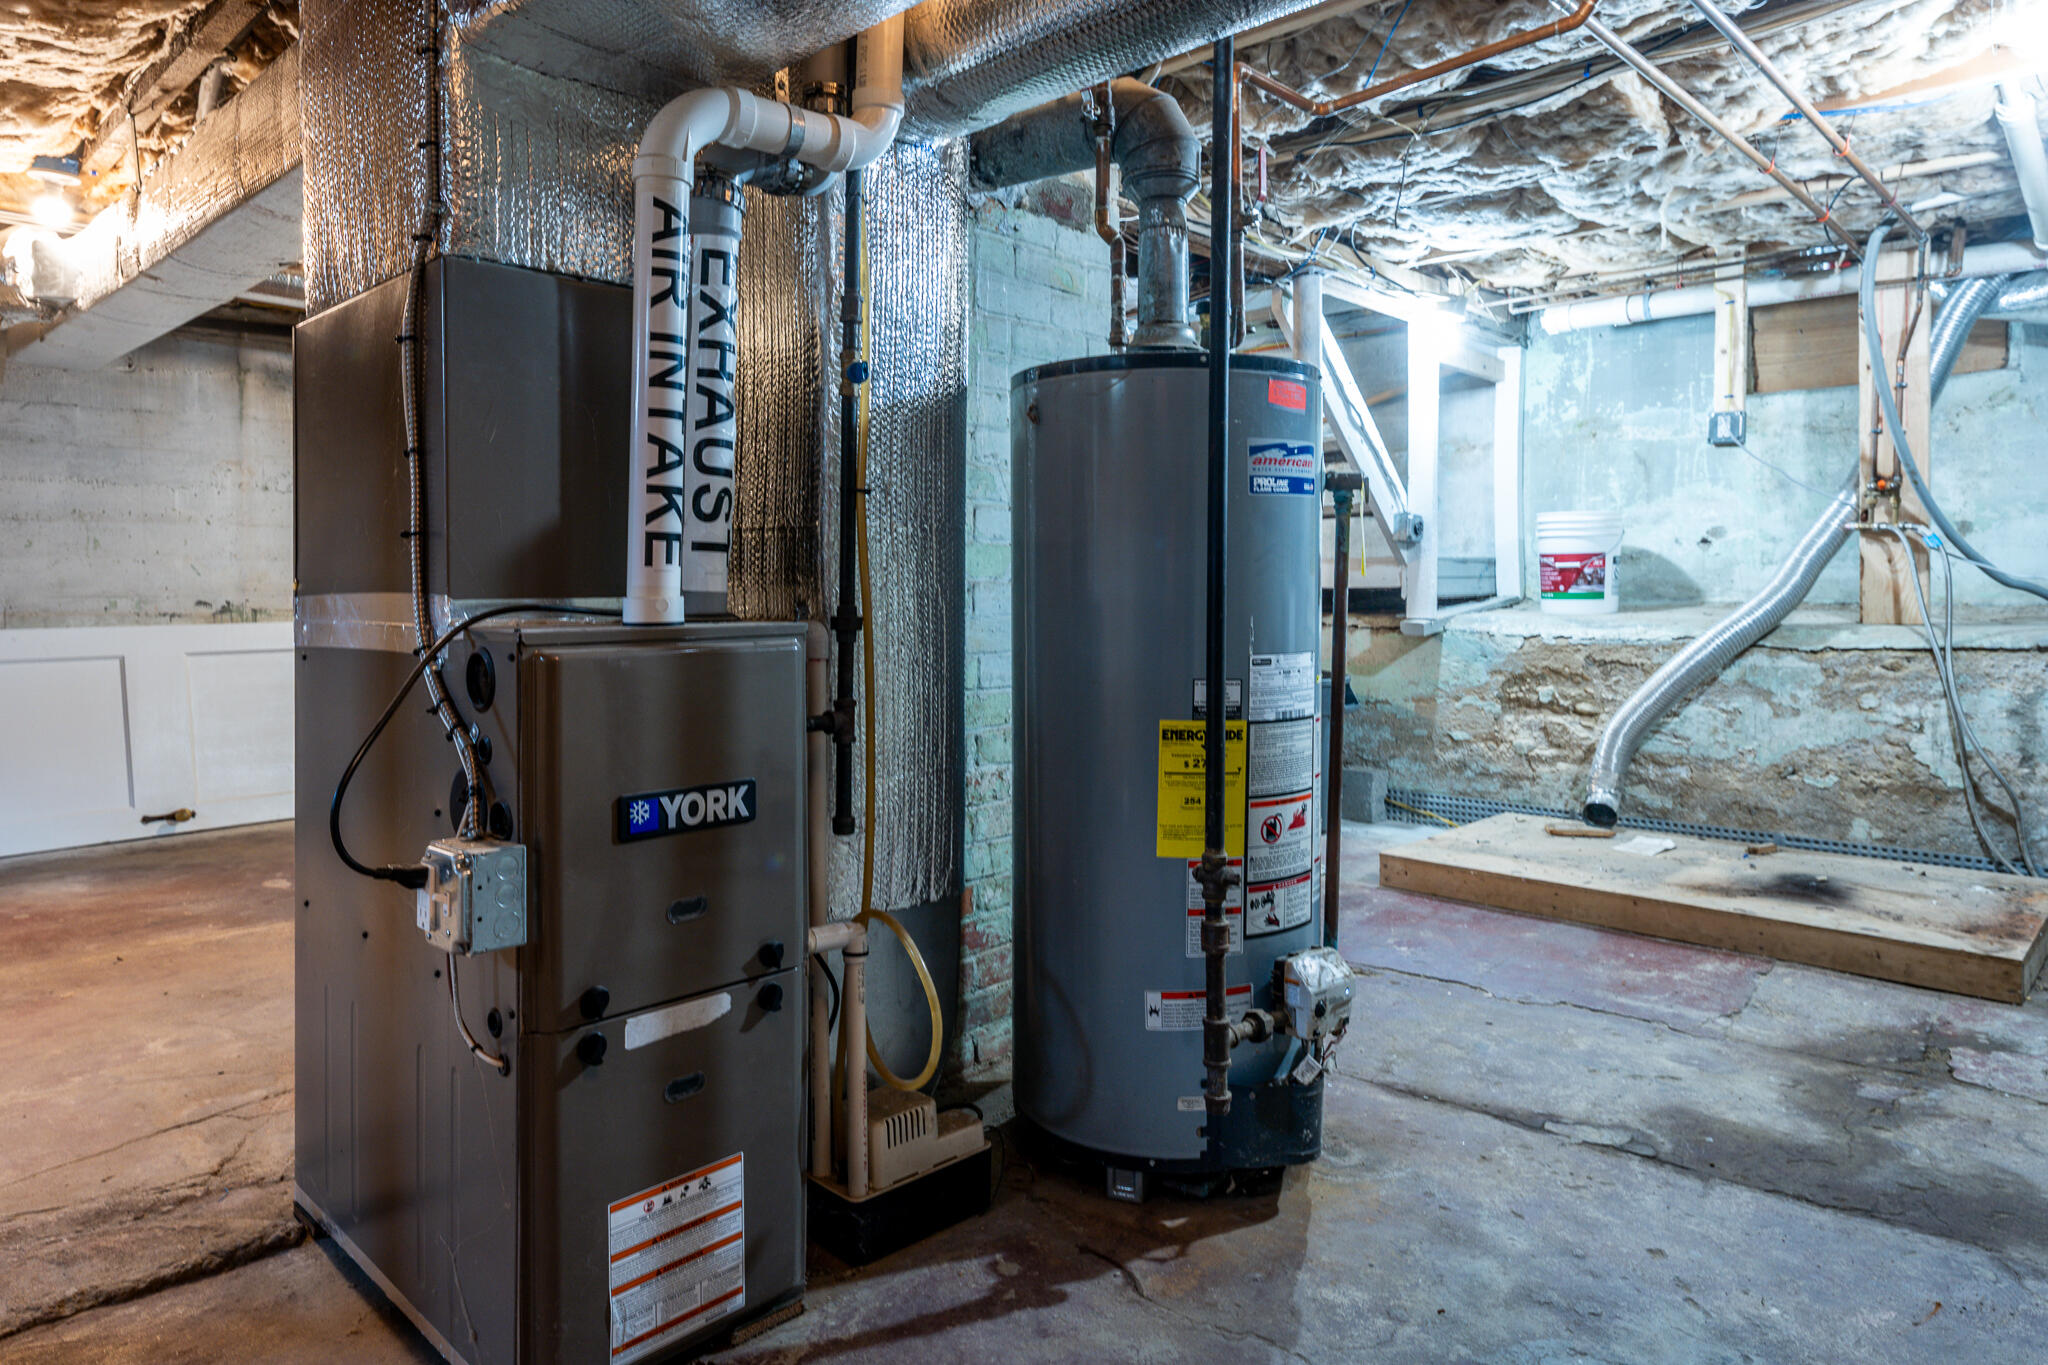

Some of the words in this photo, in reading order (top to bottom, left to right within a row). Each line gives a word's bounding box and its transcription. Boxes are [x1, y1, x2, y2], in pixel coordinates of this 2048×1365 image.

[651, 196, 689, 310] AIR
[645, 332, 687, 567] INTAKE
[691, 248, 738, 567] EXHAUST
[1252, 457, 1312, 468] american
[659, 784, 750, 830] YORK
